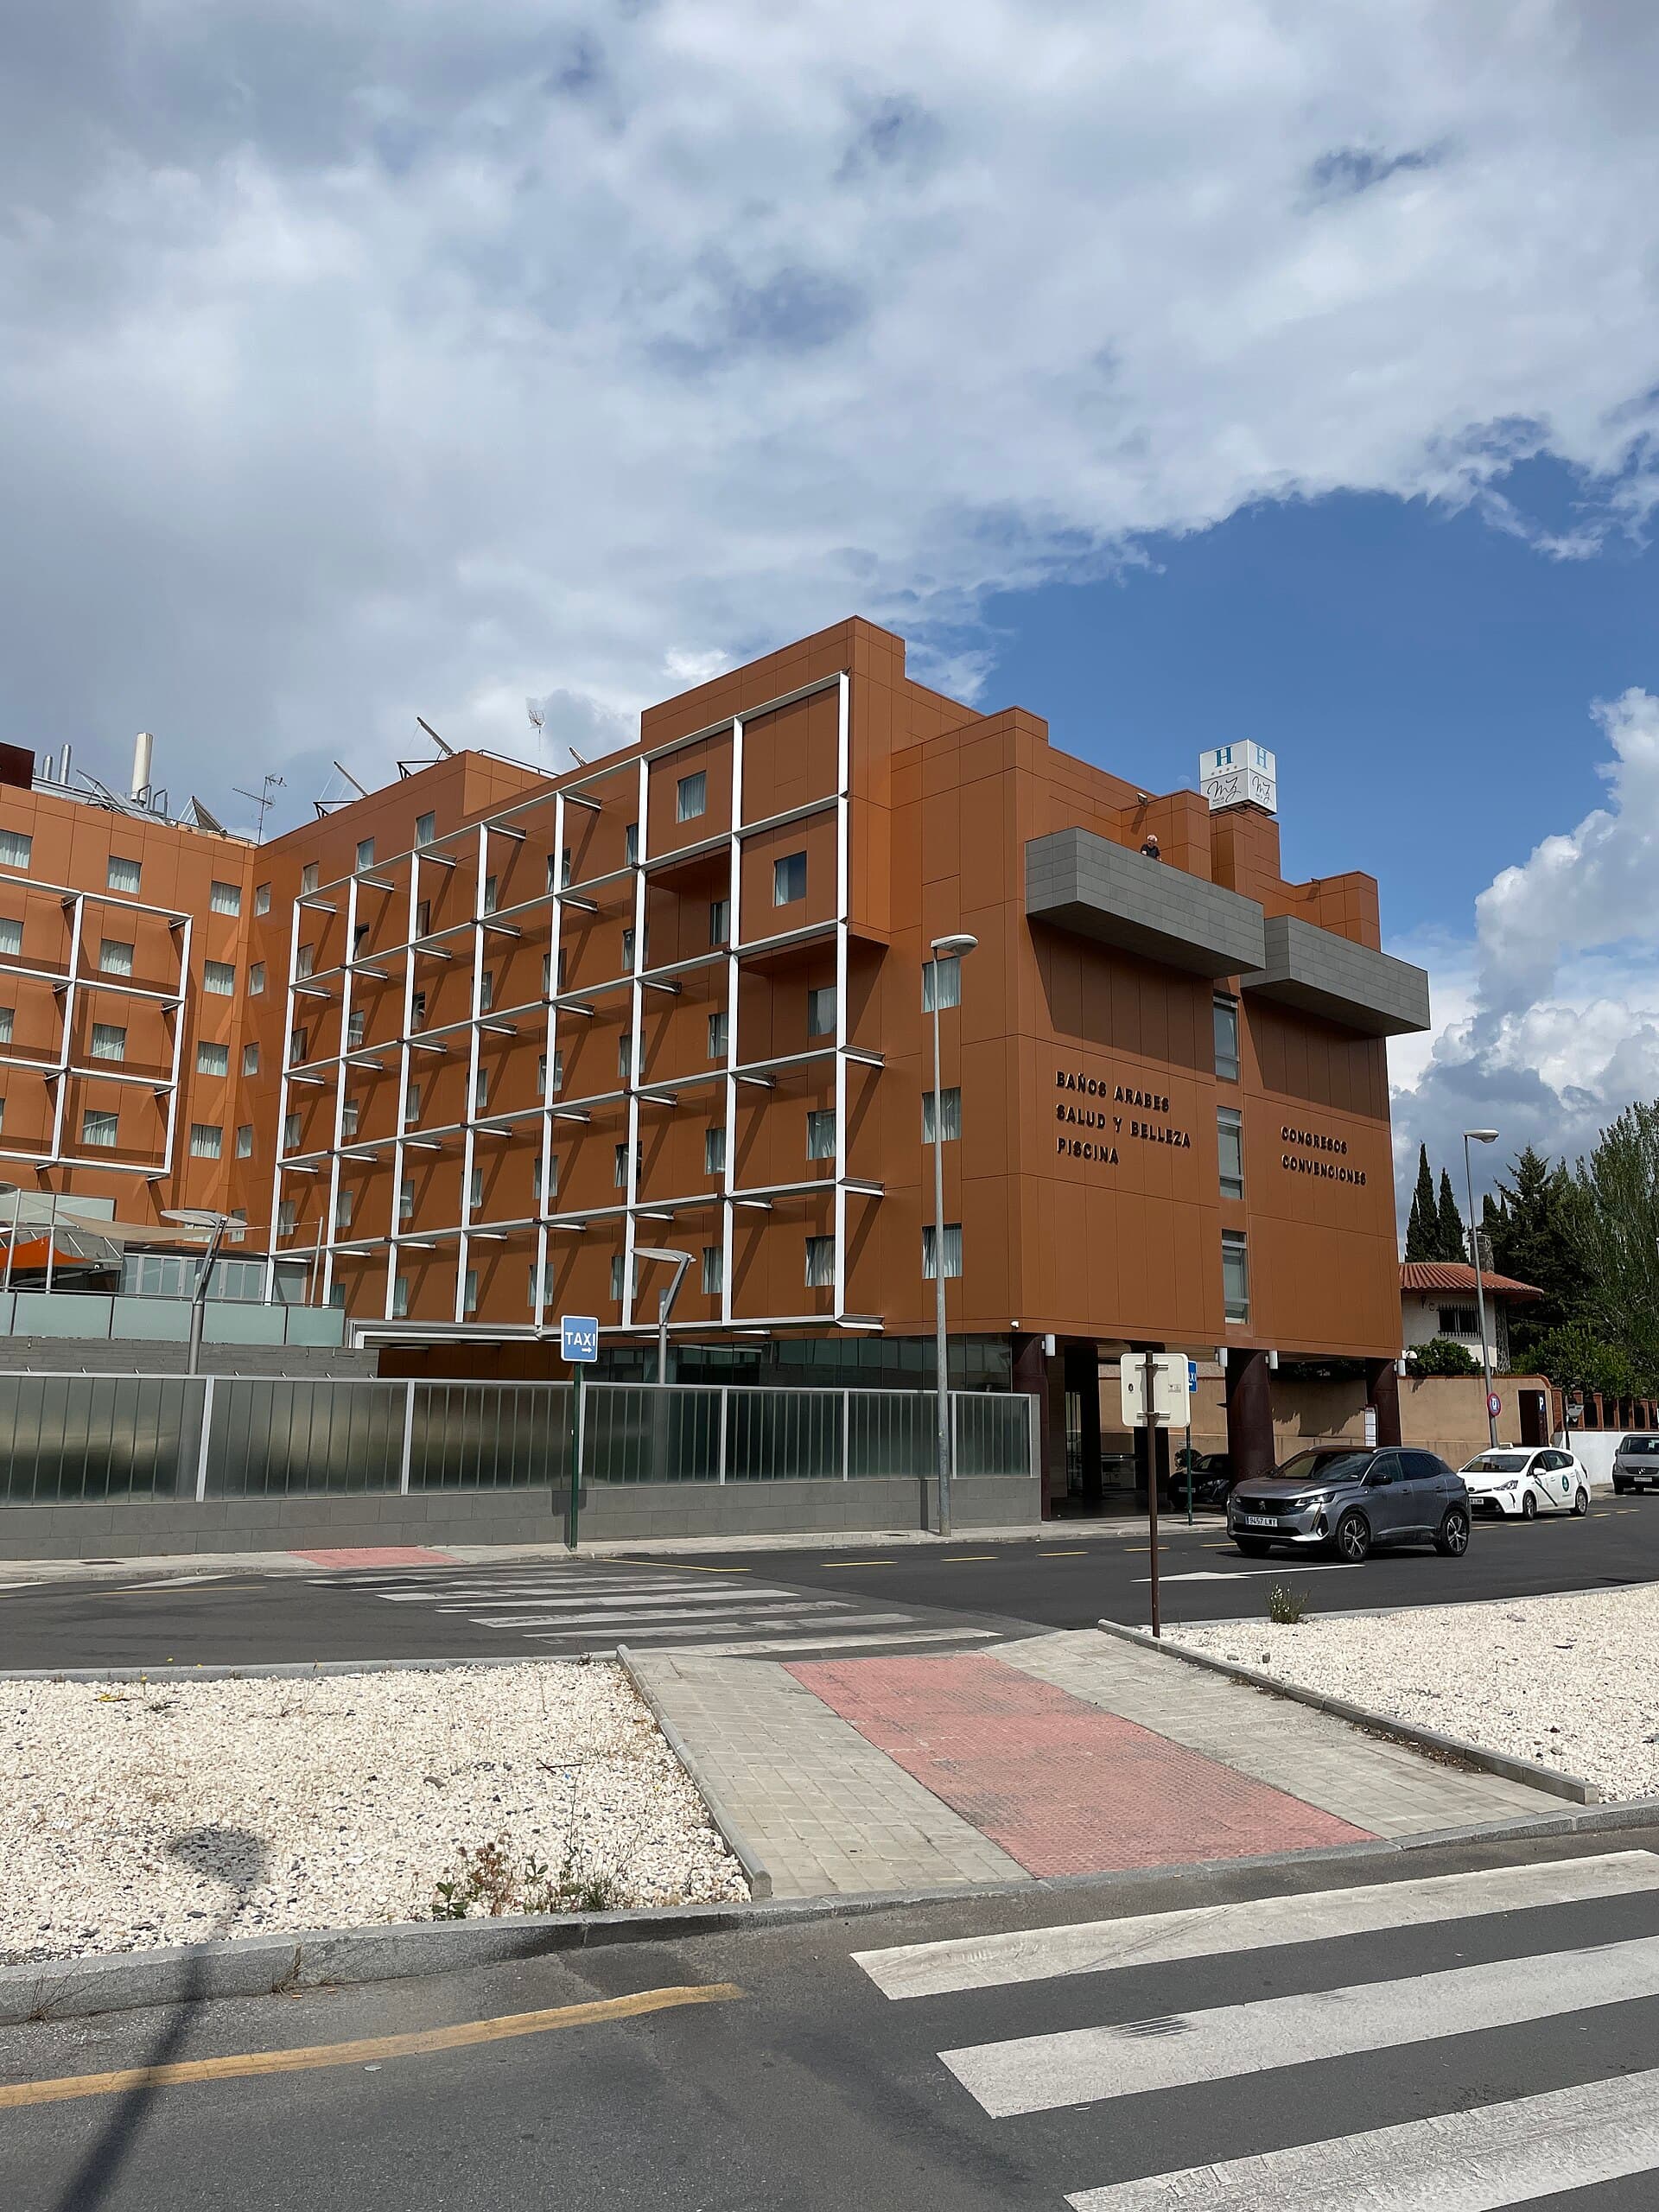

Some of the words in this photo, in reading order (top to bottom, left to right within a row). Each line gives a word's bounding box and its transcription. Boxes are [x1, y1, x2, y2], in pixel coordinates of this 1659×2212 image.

[1215, 746, 1233, 768] H
[1256, 746, 1268, 770] H
[1056, 1071, 1107, 1097] BAÑOS
[1114, 1085, 1169, 1112] ARABES
[1056, 1104, 1106, 1129] SALUD
[1113, 1117, 1122, 1133] Y
[1130, 1121, 1191, 1148] BELLEZA
[1281, 1126, 1348, 1154] CONGRESOS
[1057, 1137, 1120, 1165] PISCINA
[1281, 1154, 1367, 1185] CONVENCIONES
[565, 1332, 596, 1346] TAXI
